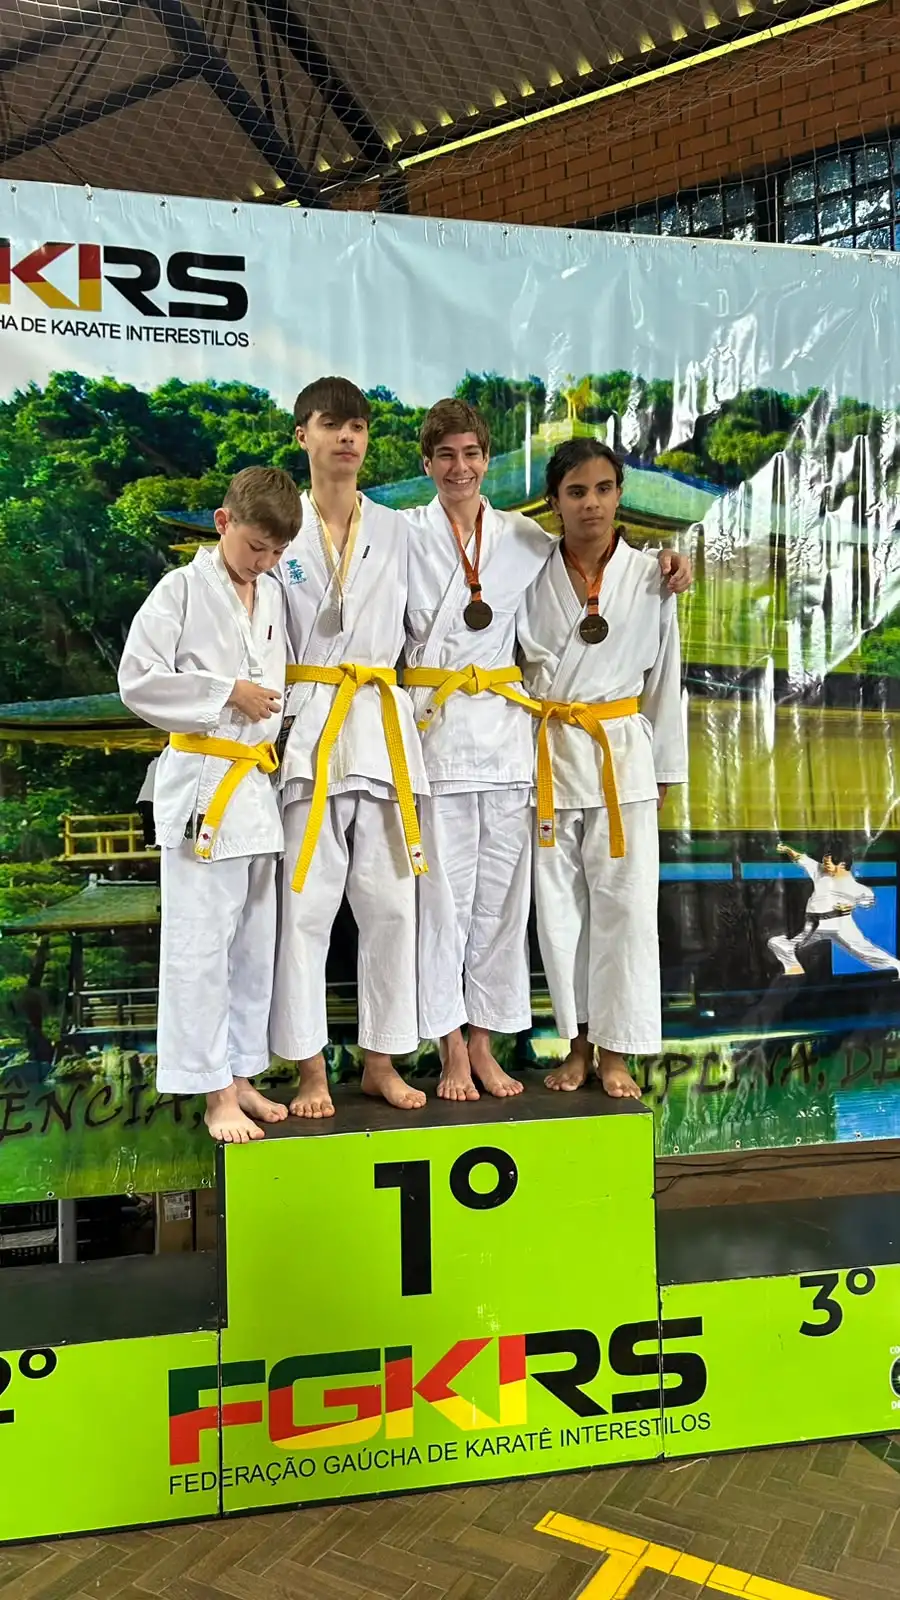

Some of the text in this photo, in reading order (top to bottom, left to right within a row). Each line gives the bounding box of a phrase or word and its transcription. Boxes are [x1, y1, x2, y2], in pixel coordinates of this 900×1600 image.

[21, 317, 46, 333] DE
[51, 319, 121, 339] KARATE
[126, 325, 249, 347] INTERESTILOS
[169, 1412, 711, 1495] FEDERAÇÃO GAÚCHA DE KARATÊ INTERESTILOS
